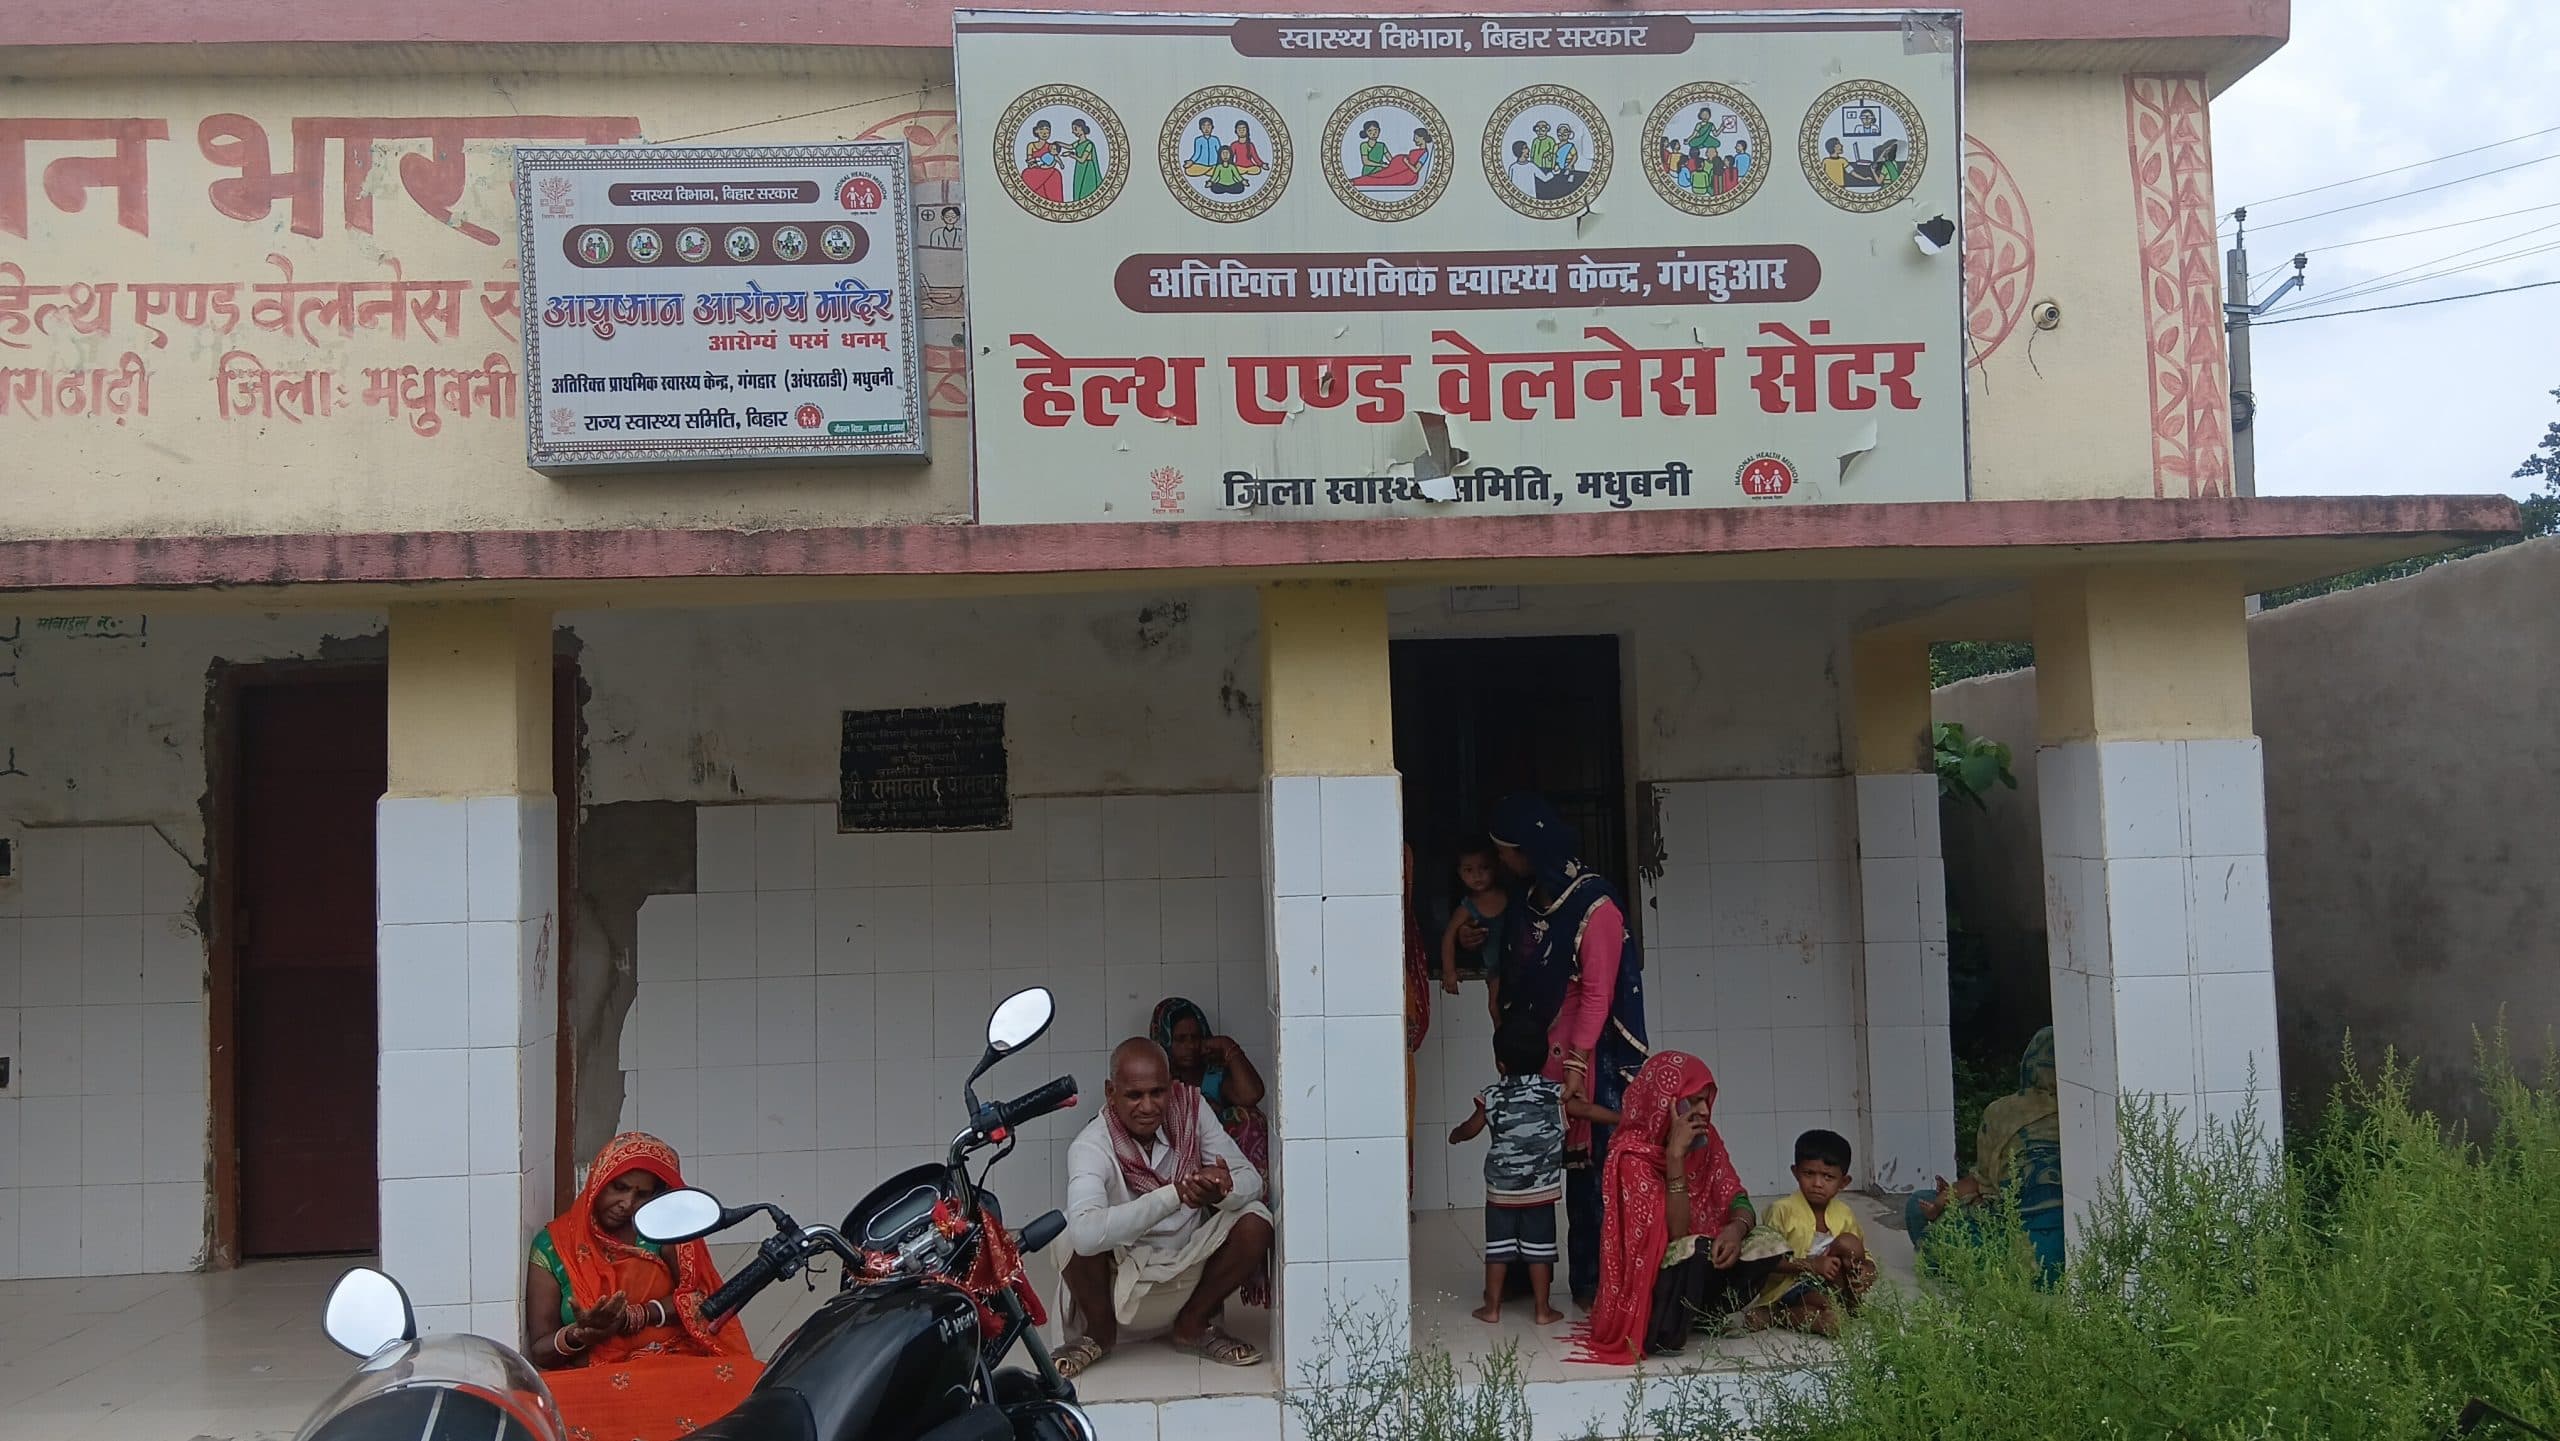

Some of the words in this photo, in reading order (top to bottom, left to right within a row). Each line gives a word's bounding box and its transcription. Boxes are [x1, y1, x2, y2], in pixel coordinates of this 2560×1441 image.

[1278, 28, 1372, 50] स्वास्थ्य
[1378, 23, 1472, 52] विभाग,
[1480, 22, 1552, 48] बिहार
[1556, 26, 1648, 47] सरकार
[197, 113, 642, 246] भार
[630, 189, 673, 201] स्वास्थ्य
[676, 186, 719, 202] विभाग,
[722, 185, 755, 200] बिहार
[757, 188, 799, 200] सरकार
[1150, 259, 1297, 298] अतिरिक्त
[1308, 258, 1438, 298] प्राथमिक
[1447, 264, 1558, 296] स्वास्थ्य
[127, 282, 244, 349] एण्ड
[252, 253, 473, 348] वेलनेस
[543, 293, 685, 340] आयुष्मान
[693, 279, 808, 324] आरोग्य
[814, 278, 894, 326] मंदिर
[709, 330, 778, 351] आरोग्यं
[789, 329, 829, 349] परमं
[841, 332, 891, 351] धनम्
[551, 374, 606, 393] अतिरिक्त
[609, 372, 658, 392] प्राथमिक
[660, 375, 701, 391] स्वास्थ्य
[852, 367, 894, 392] मधुबनी
[1010, 333, 1205, 427] हेल्थ
[1227, 354, 1411, 425] एण्ड
[1432, 326, 1725, 423] वेलनेस
[1746, 319, 1926, 413] सेंटर
[584, 415, 621, 431] राज्य
[625, 414, 681, 431] स्वास्थ्य
[684, 407, 741, 430] समिति,
[746, 407, 788, 428] बिहार
[1756, 452, 1781, 460] HEALTH
[1223, 471, 1316, 507] जिला
[1576, 461, 1693, 508] मधुबनी
